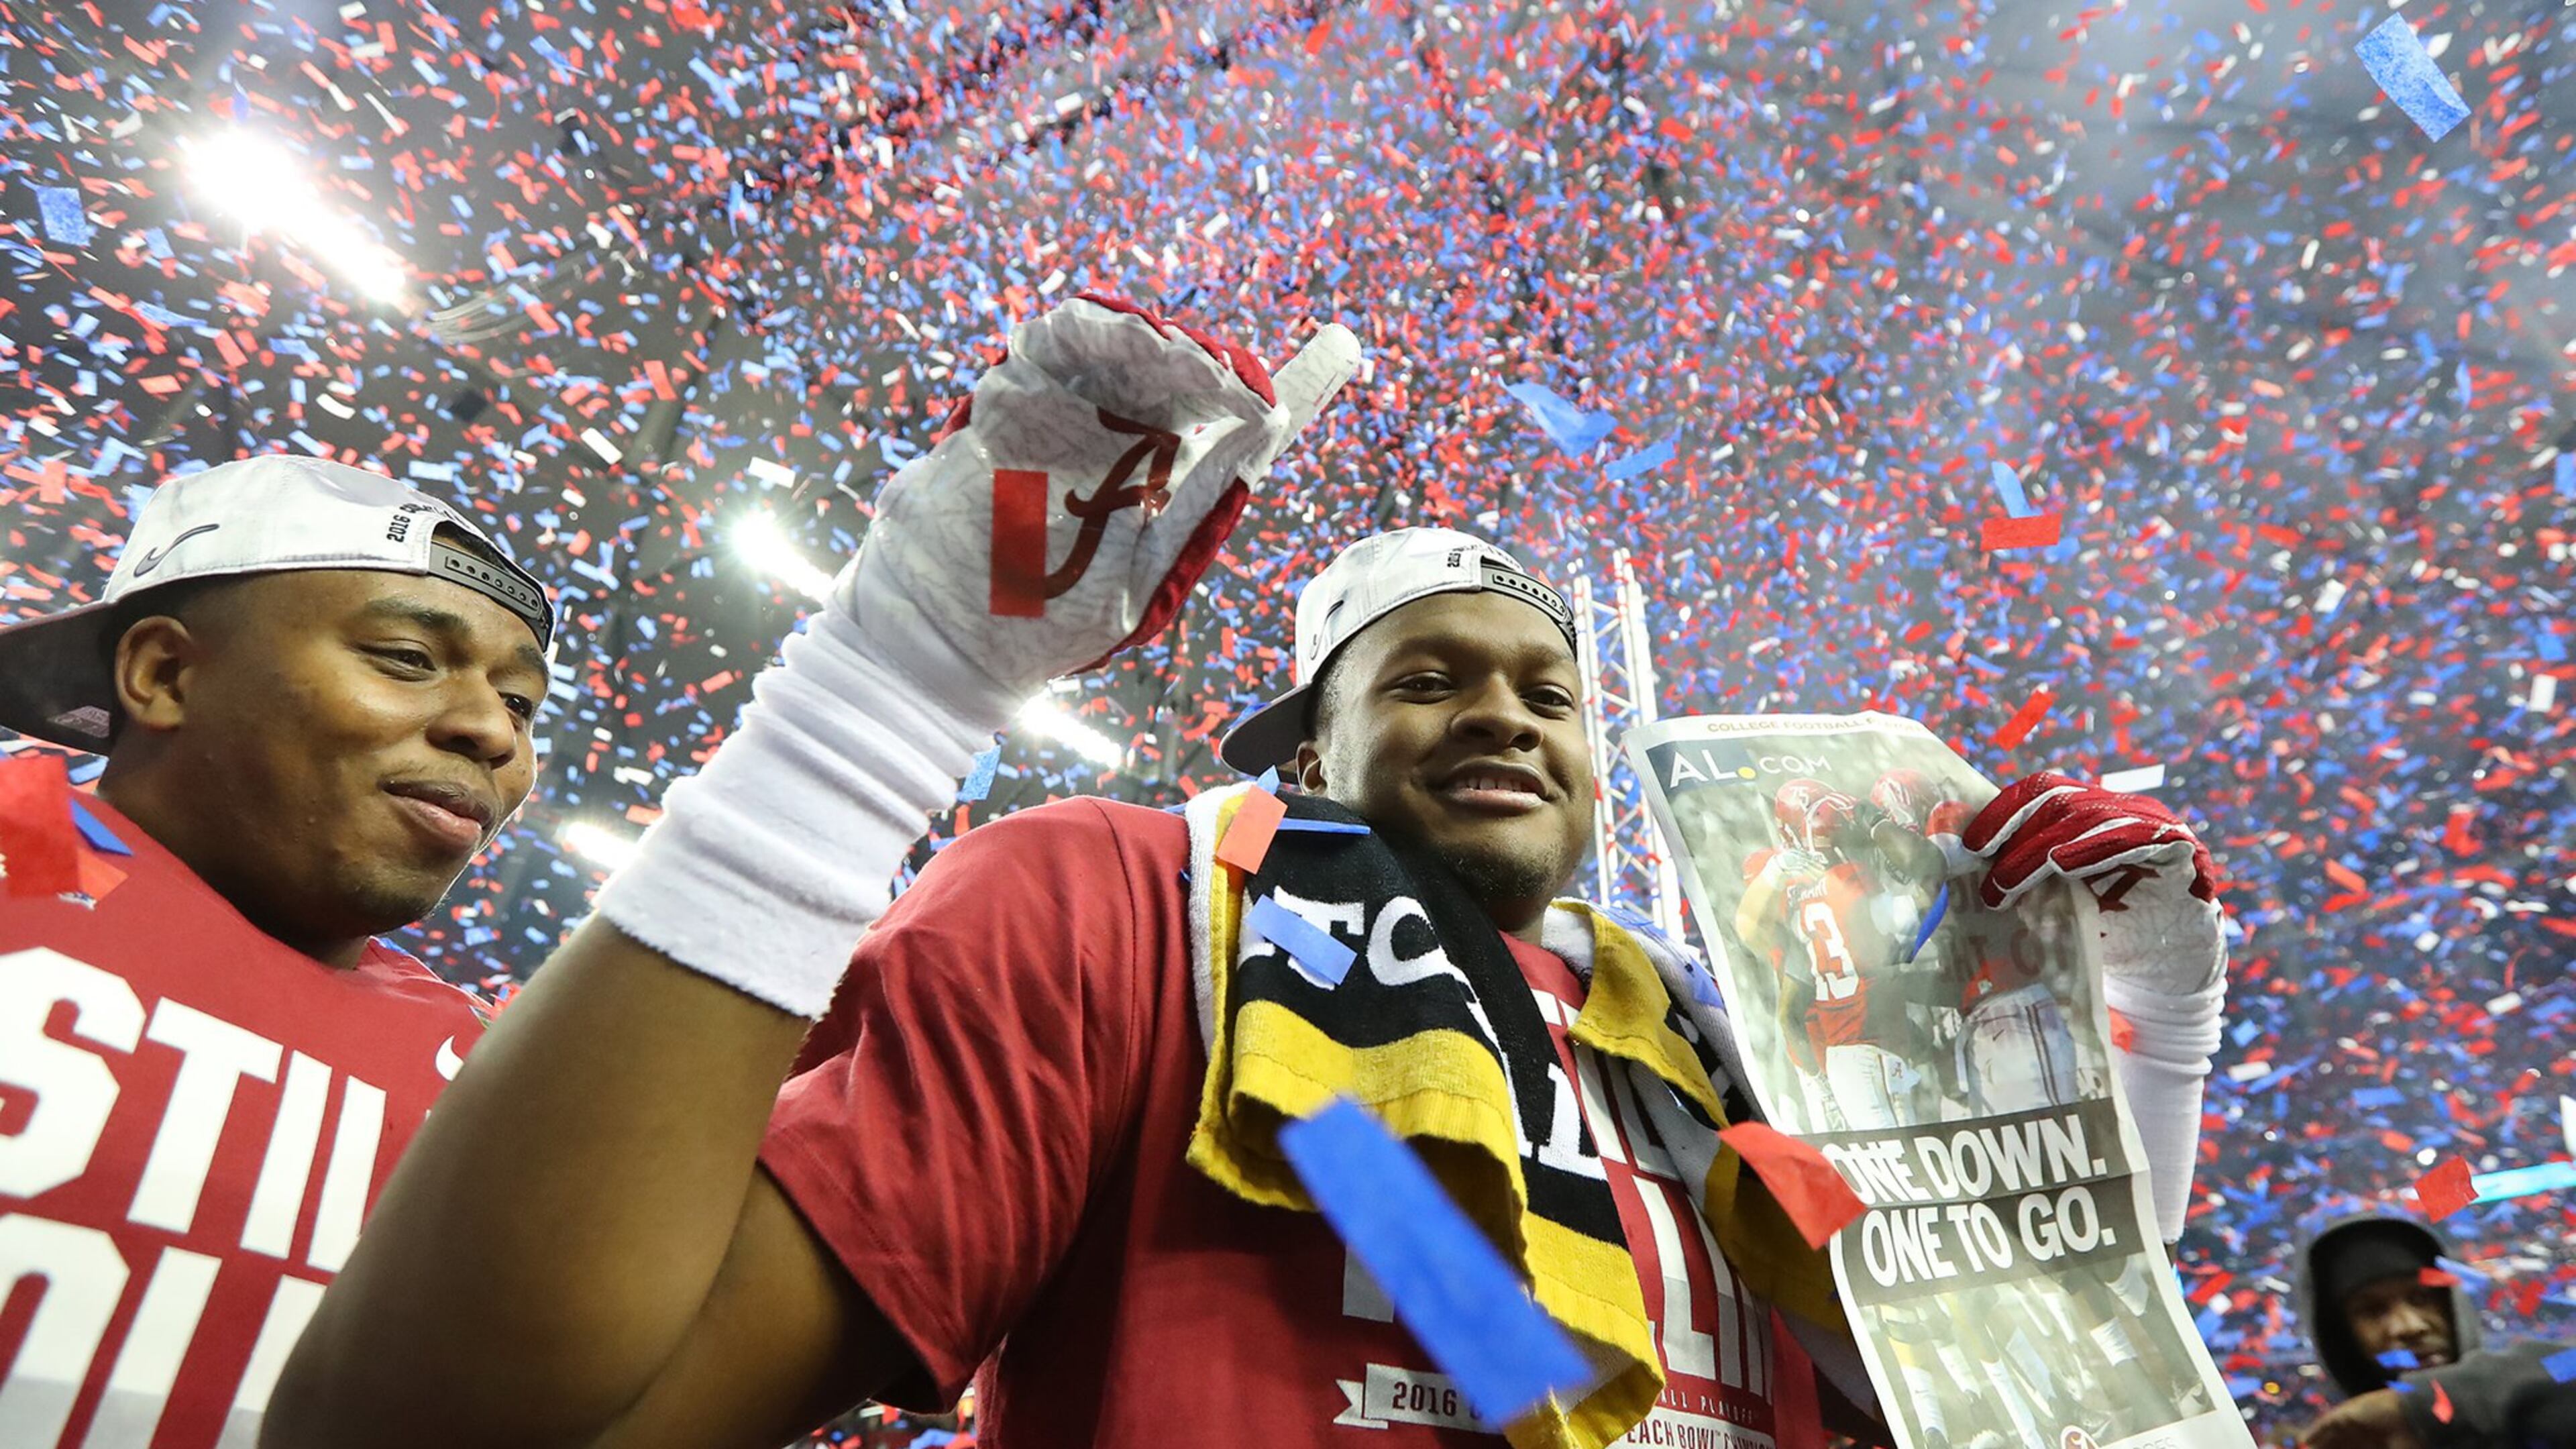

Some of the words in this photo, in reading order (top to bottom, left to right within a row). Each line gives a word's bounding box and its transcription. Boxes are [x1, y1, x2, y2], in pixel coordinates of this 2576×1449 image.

[386, 515, 411, 543] 2016
[1707, 722, 1779, 733] COLLEGE
[1783, 718, 1864, 731] FOOTBALL
[1822, 1140, 1933, 1205] ONE
[1914, 1114, 2108, 1199] DOWN.
[1862, 1206, 1959, 1288] ONE
[1947, 1203, 2013, 1273] TO
[2019, 1187, 2117, 1261] GO.
[1392, 1381, 1457, 1417] 2016
[1626, 1418, 1675, 1447] EACH
